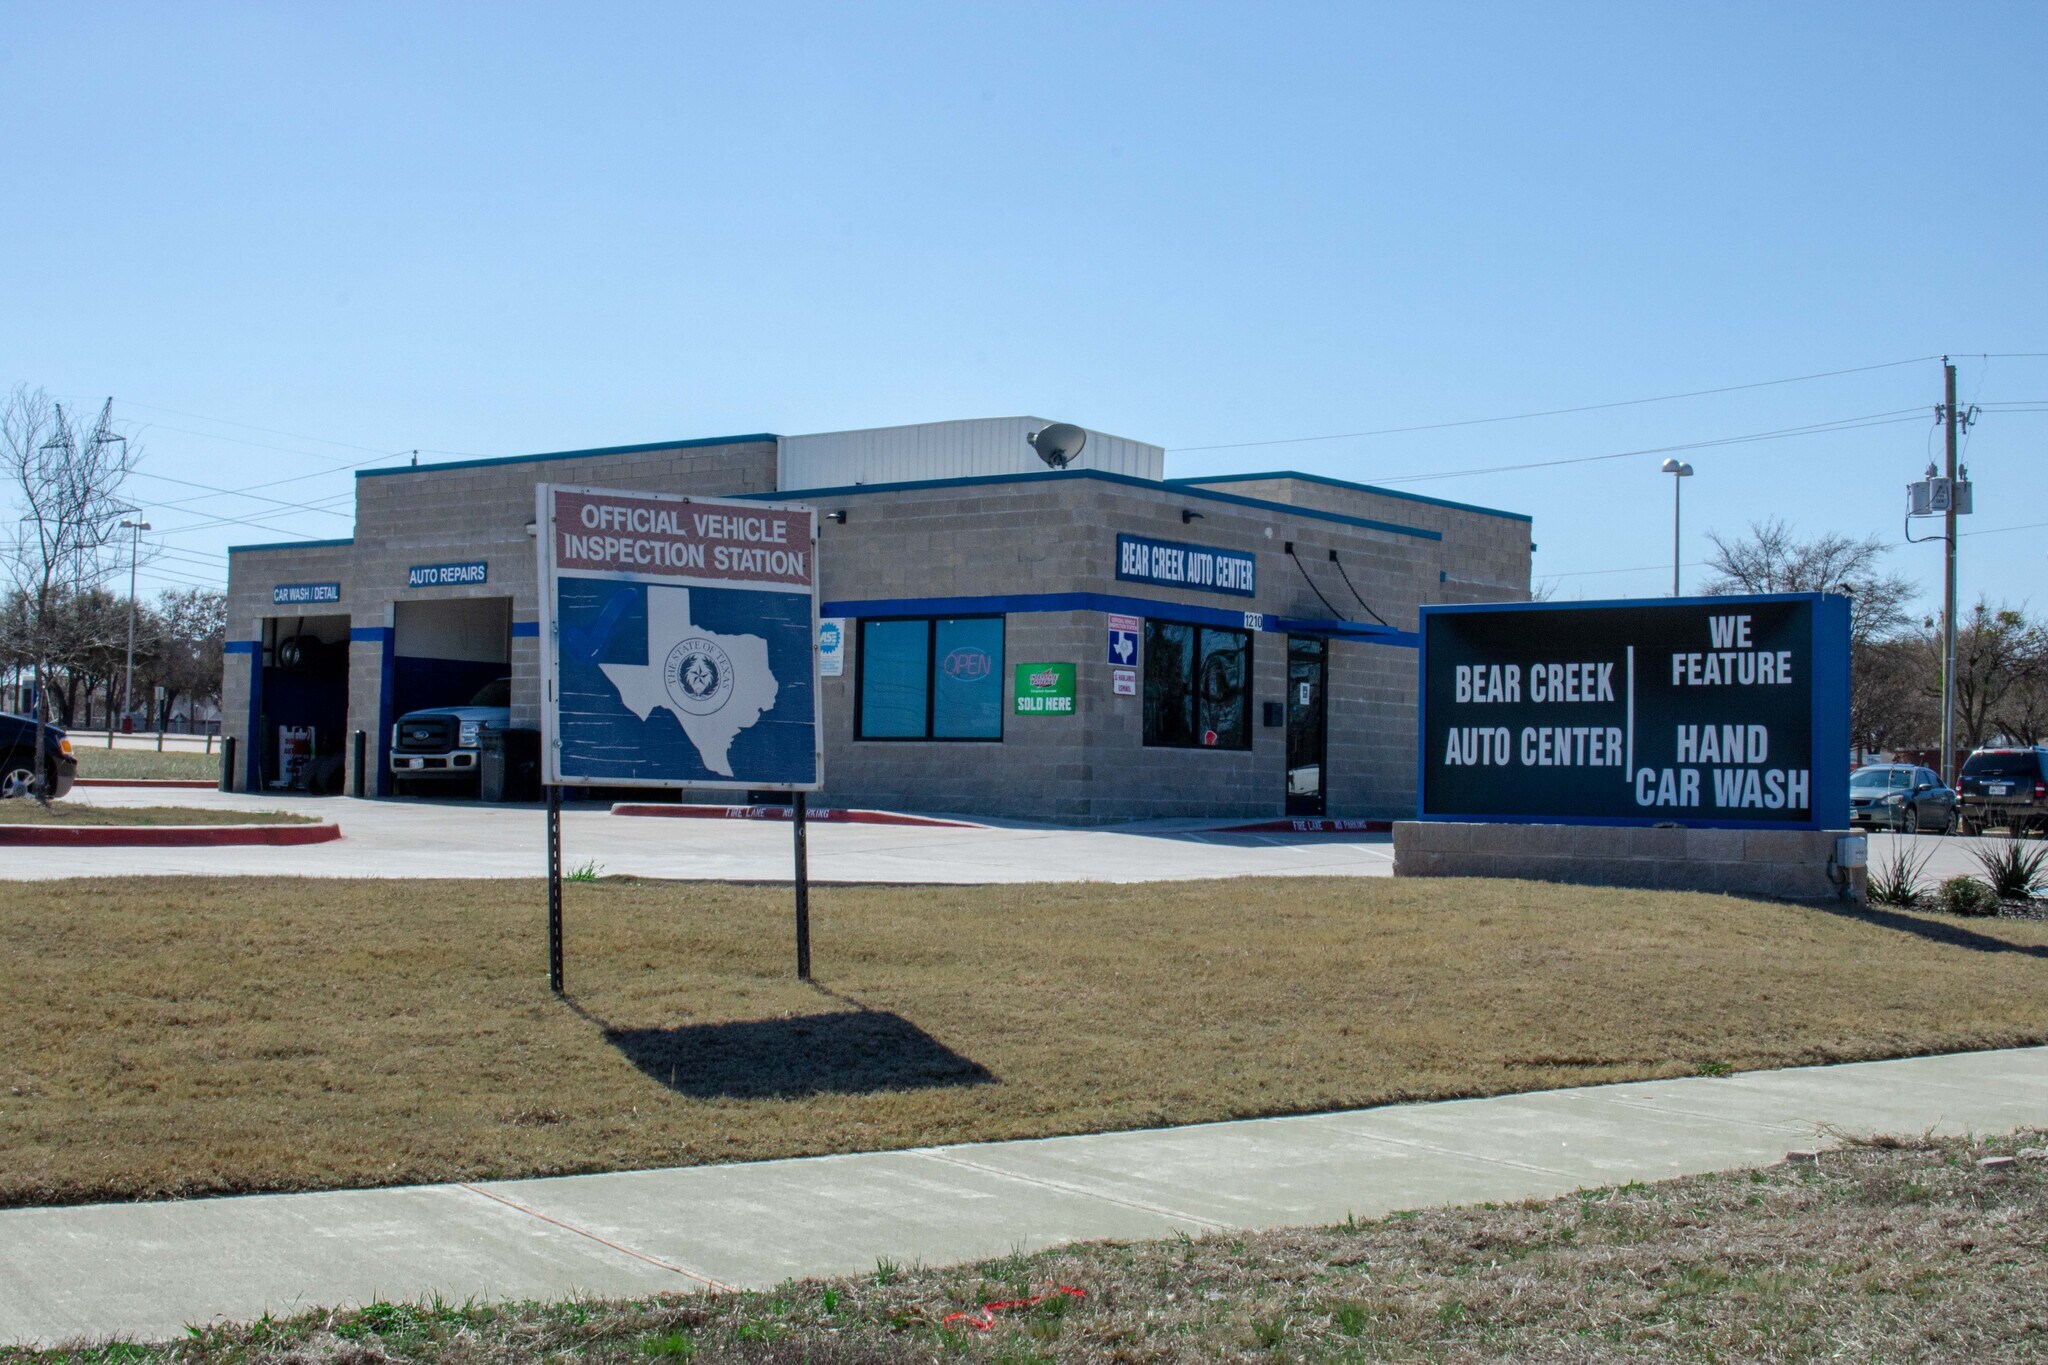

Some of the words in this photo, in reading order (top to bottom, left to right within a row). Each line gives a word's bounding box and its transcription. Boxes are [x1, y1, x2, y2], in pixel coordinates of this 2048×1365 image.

[580, 503, 686, 536] OFFICIAL
[693, 513, 787, 544] VEHICLE
[564, 533, 705, 568] INSPECTION
[714, 546, 804, 576] STATION
[1121, 541, 1149, 577] BEAR
[1151, 545, 1185, 582] CREEK
[1187, 551, 1214, 586] AUTO
[1216, 555, 1253, 591] CENTER
[409, 569, 438, 584] AUTO
[440, 565, 485, 582] REPAIRS
[273, 588, 288, 602] CAR
[289, 587, 309, 601] WASH
[314, 586, 338, 600] DETAIL
[819, 631, 838, 643] ASE
[1245, 614, 1263, 629] 1210
[1709, 615, 1753, 649] WE
[667, 662, 677, 688] THE
[672, 640, 701, 660] STATE
[702, 642, 717, 653] OF
[716, 650, 731, 690] TEXAS
[943, 653, 992, 675] OPEN
[1672, 650, 1792, 686] FEATURE
[1455, 664, 1521, 703] BEAR
[1529, 662, 1615, 703] CREEK
[1017, 696, 1044, 711] SOLD
[1045, 696, 1072, 711] HERE
[1444, 726, 1510, 766] AUTO
[1520, 726, 1623, 766] CENTER
[1677, 724, 1768, 764] HAND
[1635, 767, 1700, 807] CAR
[1713, 769, 1809, 809] WASH
[725, 807, 743, 818] FIRE
[745, 807, 767, 818] LANE
[805, 809, 830, 818] RKING
